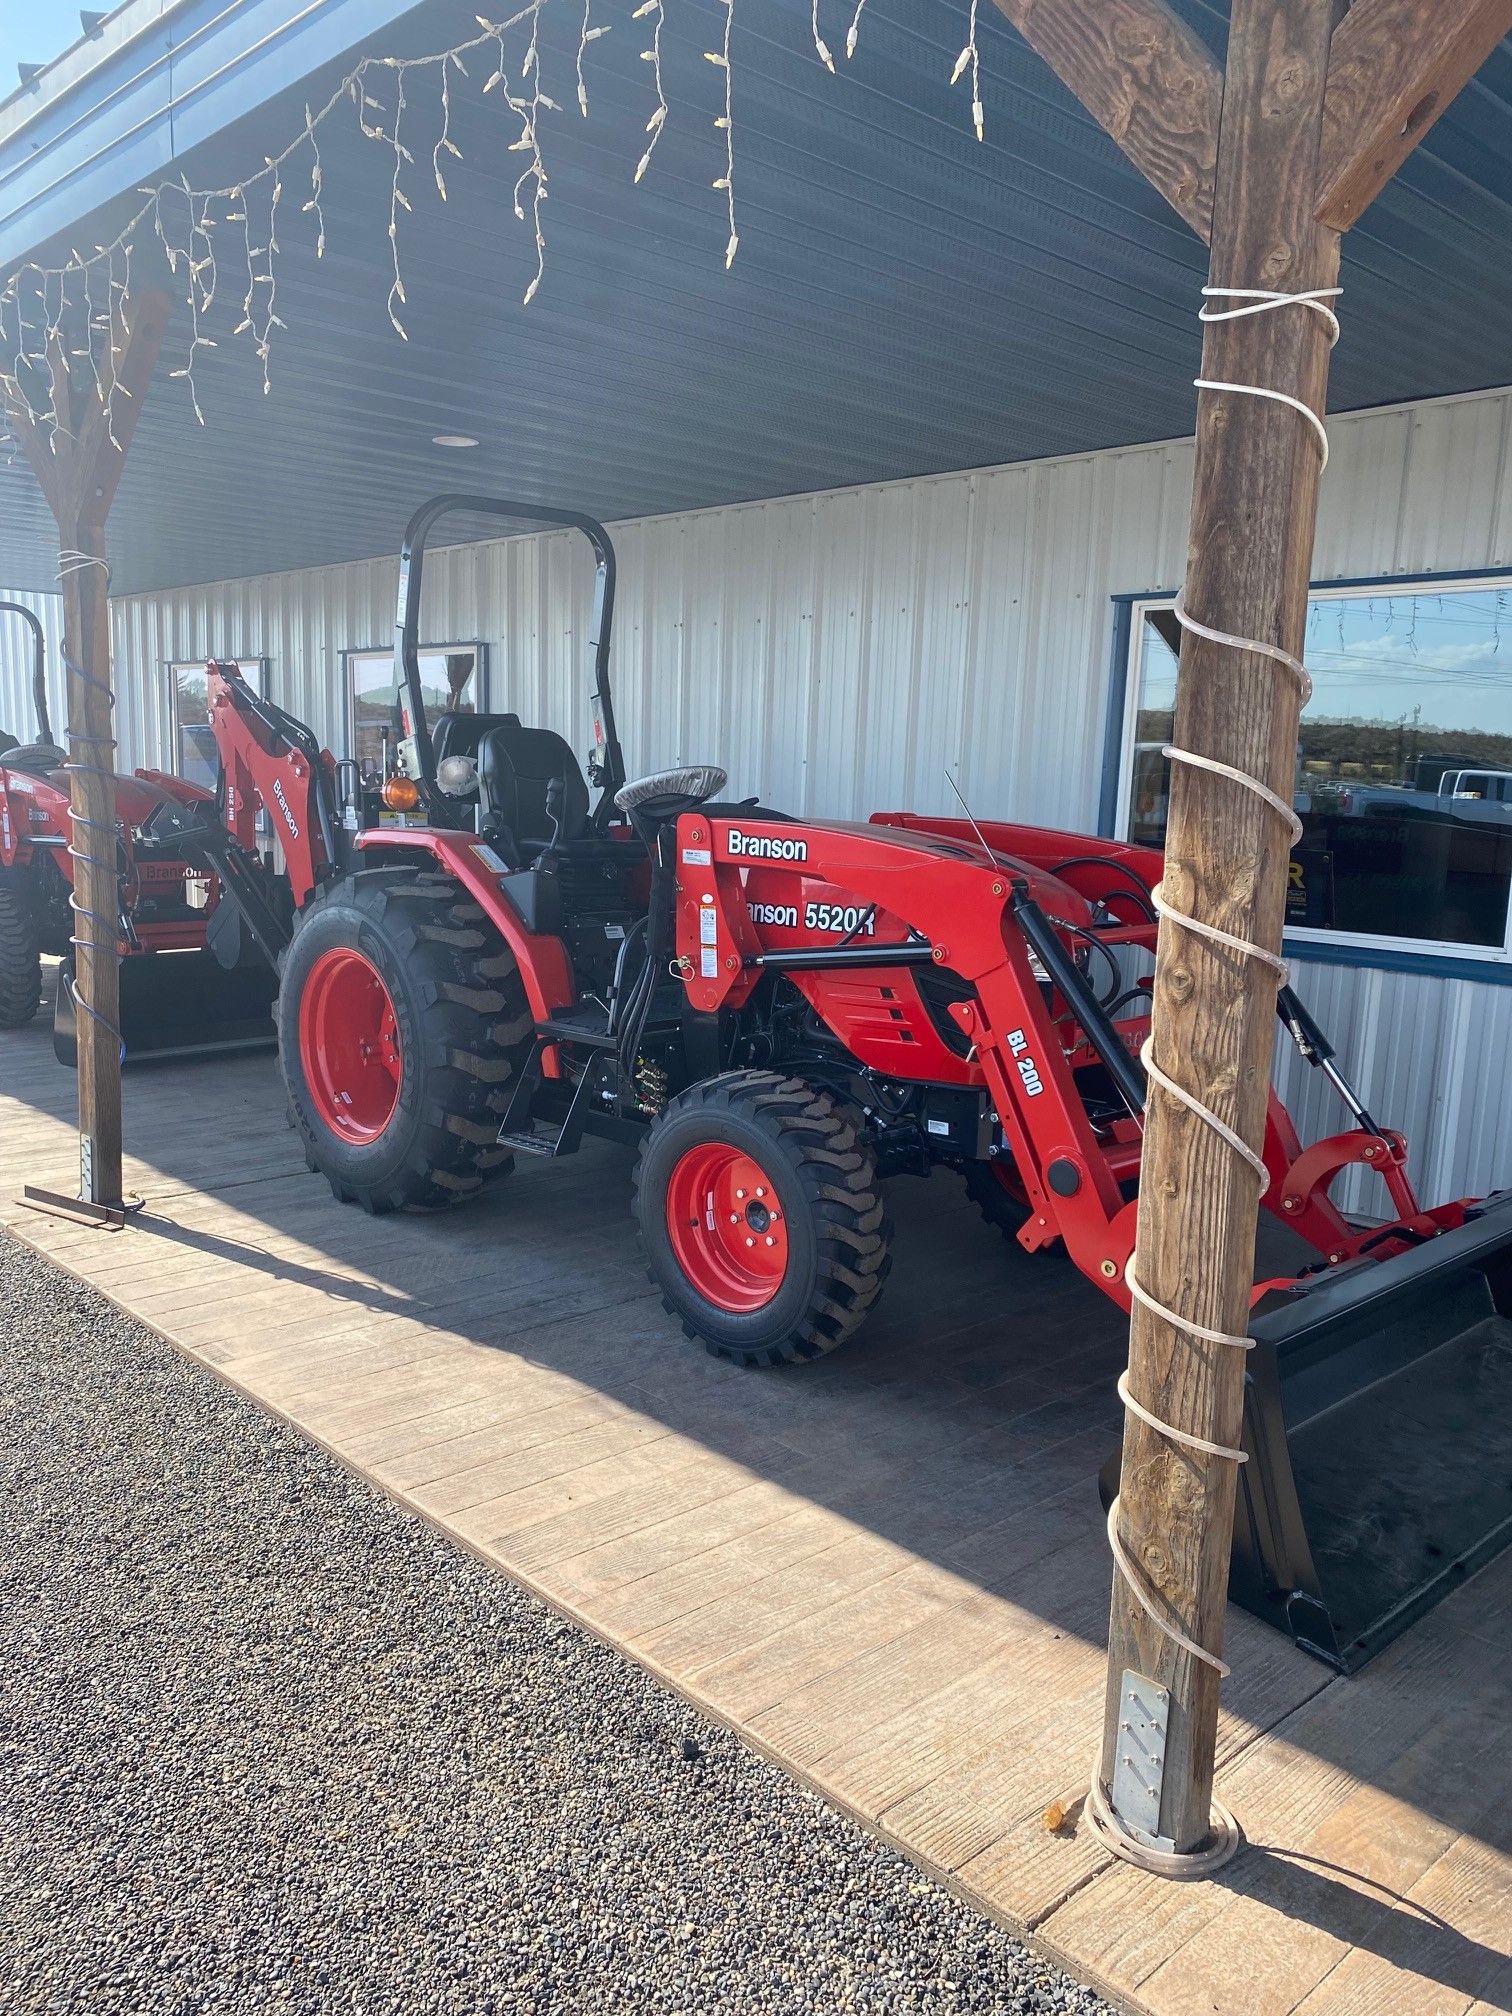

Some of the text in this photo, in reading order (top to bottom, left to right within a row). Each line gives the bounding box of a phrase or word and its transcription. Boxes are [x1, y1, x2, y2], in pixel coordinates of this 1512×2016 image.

[10, 775, 34, 795] Branson
[28, 808, 50, 822] Branson
[228, 807, 235, 821] BH
[273, 778, 299, 839] Branson
[728, 829, 807, 861] Branson
[146, 866, 202, 880] Branson
[746, 902, 875, 935] anson 5520R
[1007, 1029, 1044, 1097] BL 200
